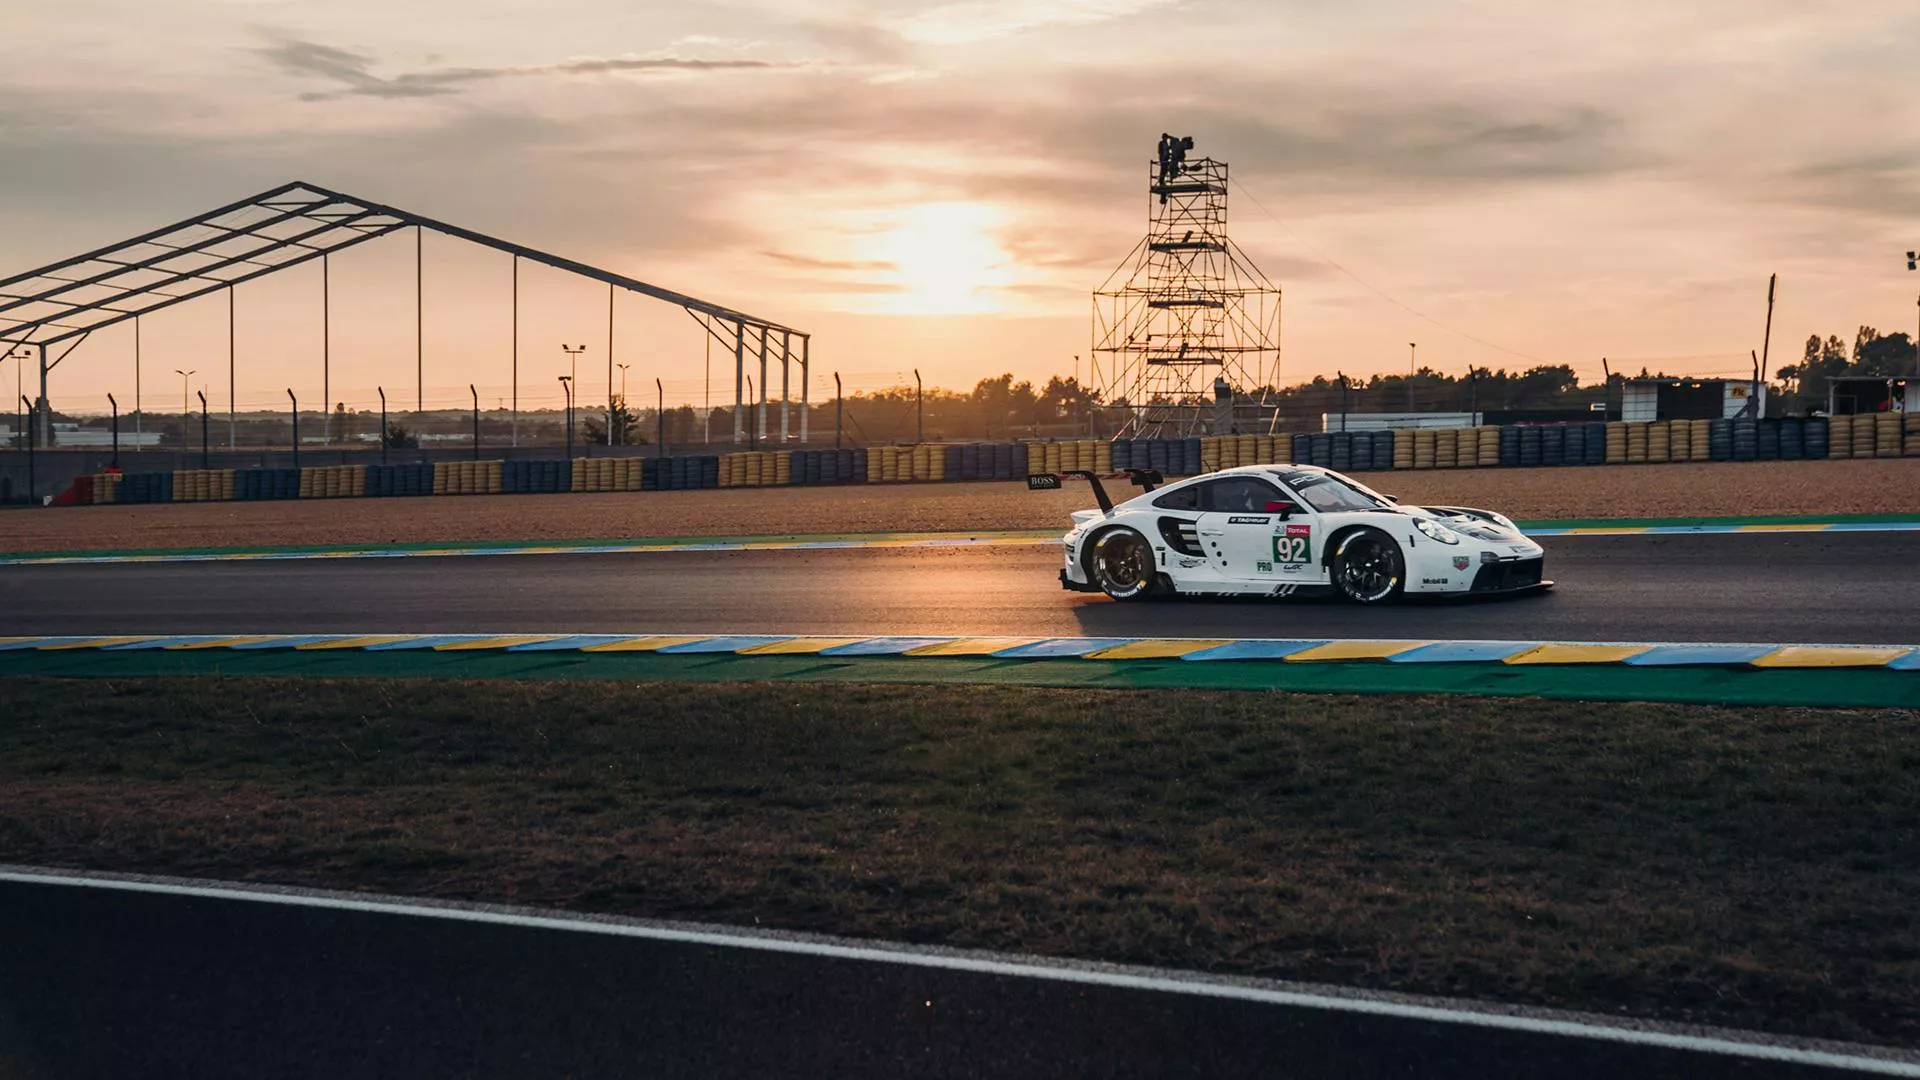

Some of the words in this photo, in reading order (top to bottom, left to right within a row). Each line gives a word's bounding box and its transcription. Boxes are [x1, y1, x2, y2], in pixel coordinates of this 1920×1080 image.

[1031, 476, 1054, 485] BOSS
[1277, 537, 1307, 562] 92
[1257, 561, 1273, 572] PRO
